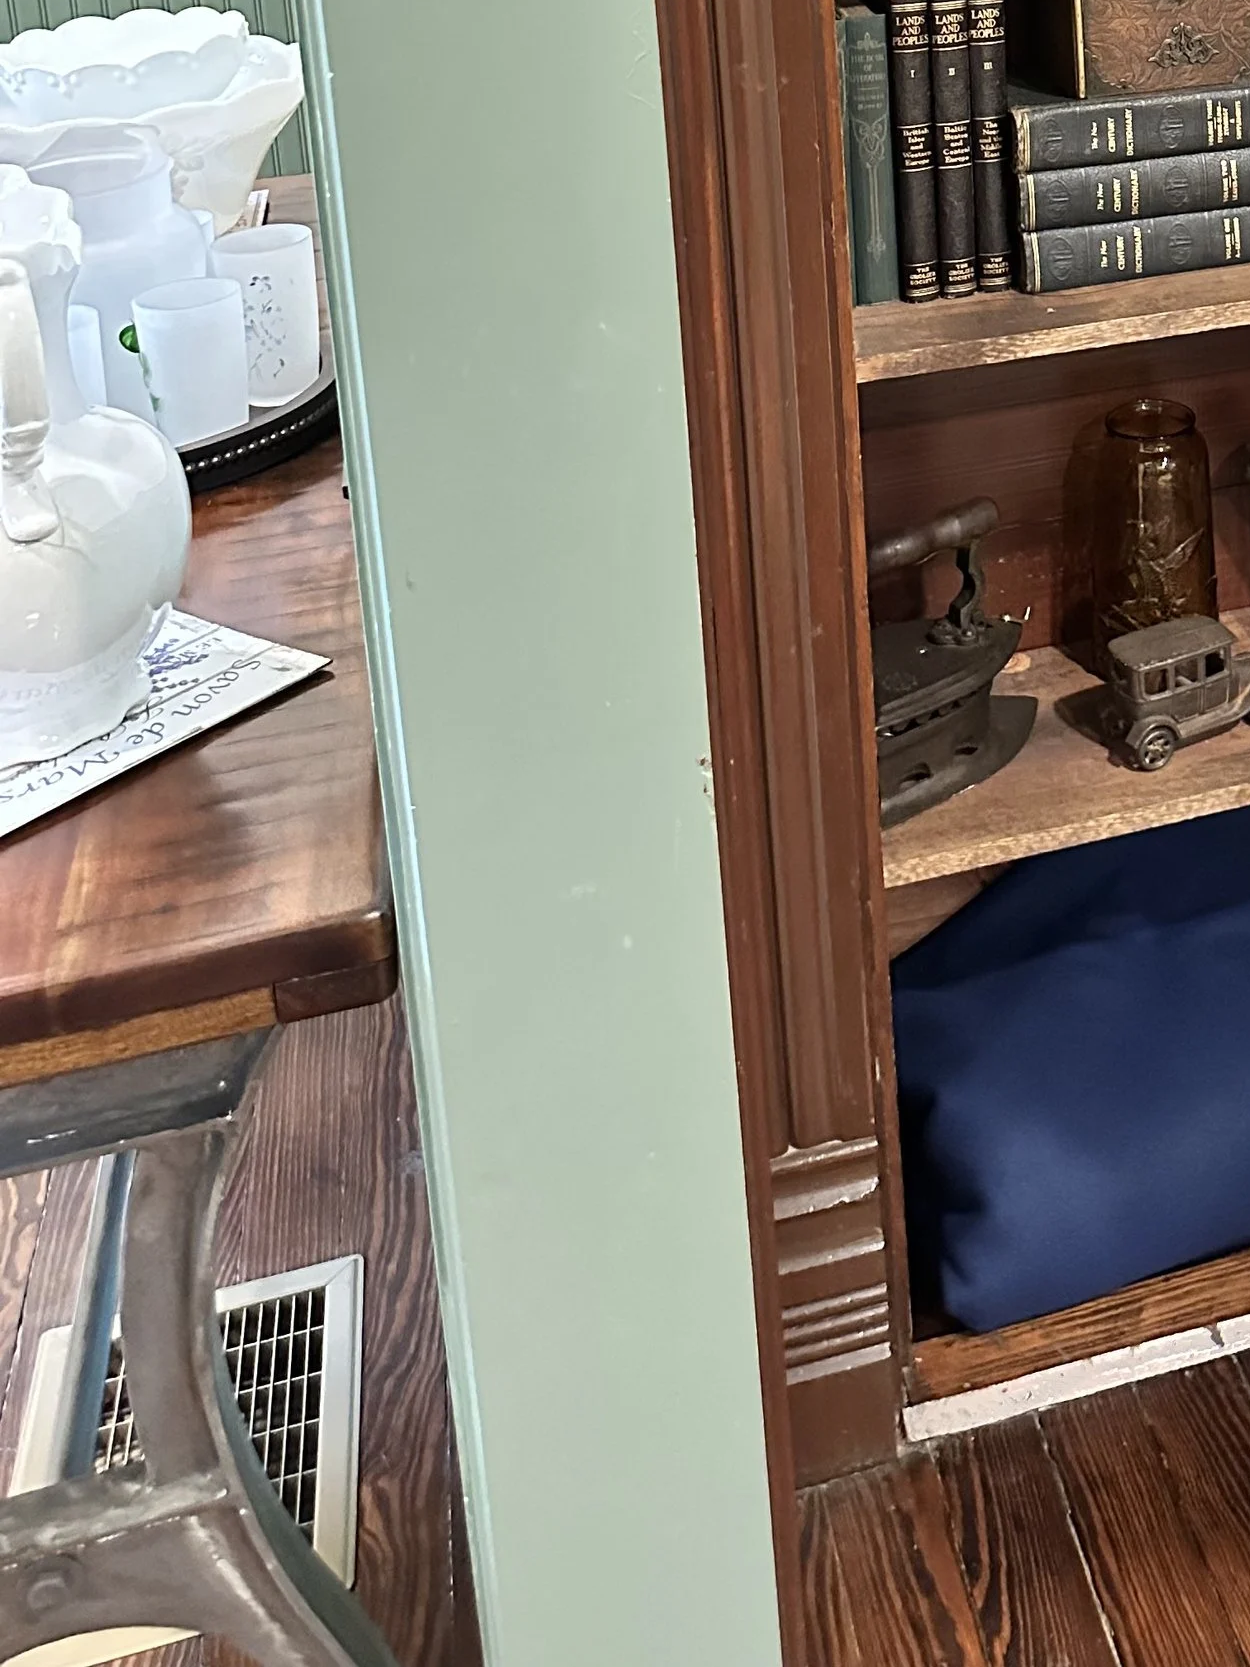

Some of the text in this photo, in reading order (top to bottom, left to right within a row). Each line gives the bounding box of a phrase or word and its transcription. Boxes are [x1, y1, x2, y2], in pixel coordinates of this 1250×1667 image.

[934, 13, 964, 25] LANDS
[971, 7, 1000, 20] LANDS
[895, 15, 926, 27] LANDS
[976, 18, 997, 29] AND
[901, 25, 921, 36] AND
[940, 23, 961, 35] AND
[969, 26, 1005, 39] PEOPLES
[892, 34, 929, 47] PEOPLES
[932, 32, 969, 44] PEOPLES
[948, 67, 956, 76] II
[983, 62, 993, 70] III
[943, 126, 967, 134] Baltic
[983, 121, 998, 129] The
[1090, 122, 1099, 150] The New
[1107, 117, 1116, 153] CENTURY
[1124, 108, 1134, 156] DICTIONARY
[950, 139, 963, 148] and
[942, 146, 970, 156] Central
[945, 155, 970, 164] Europe
[1112, 177, 1122, 213] CENTURY
[1130, 168, 1140, 215] DICTIONARY
[1116, 235, 1126, 271] CENTURY
[1133, 225, 1143, 273] DICTIONARY
[171, 659, 261, 717] Savon
[126, 722, 165, 745] de
